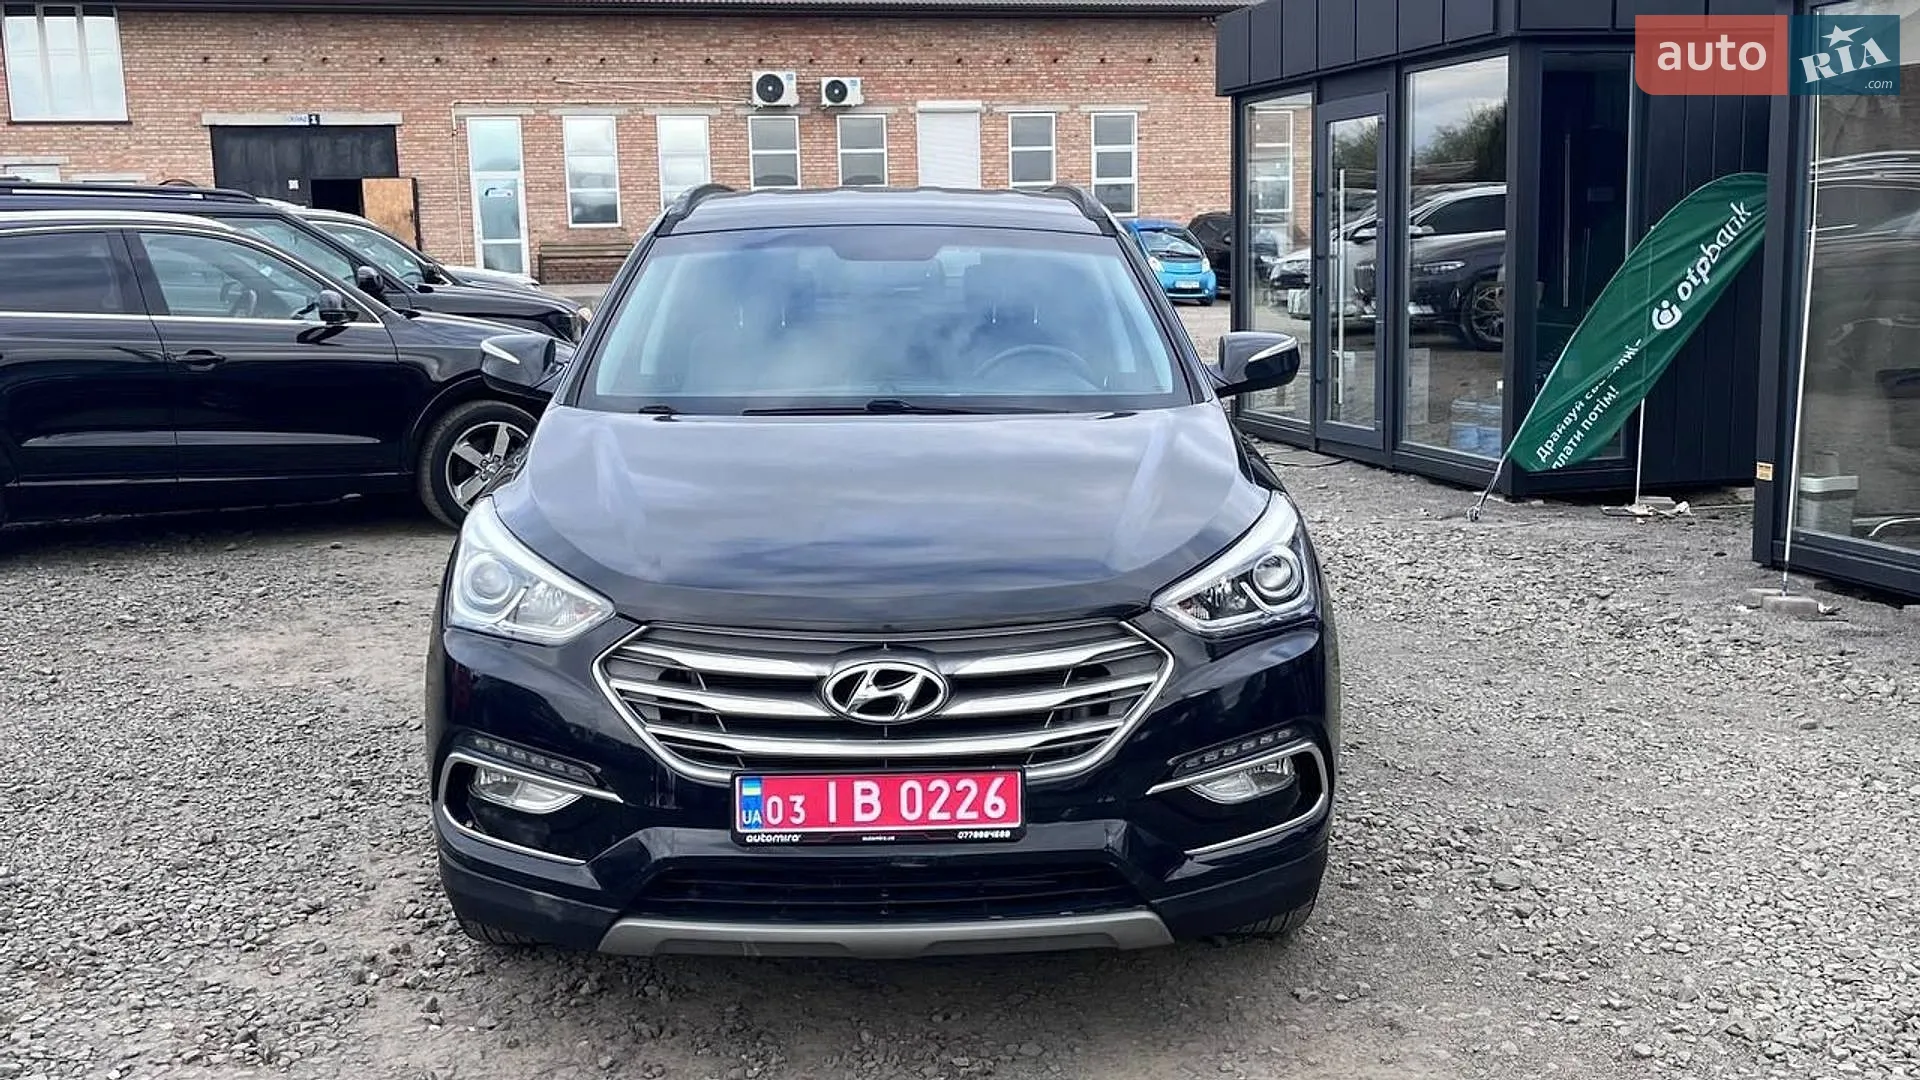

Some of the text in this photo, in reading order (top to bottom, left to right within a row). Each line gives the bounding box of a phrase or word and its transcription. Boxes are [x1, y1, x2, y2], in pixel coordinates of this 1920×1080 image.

[1677, 202, 1751, 301] otpbank
[1536, 400, 1585, 463] Драйвуй
[1552, 385, 1620, 470] плати потім!
[743, 809, 762, 825] UA
[766, 795, 806, 825] 03
[900, 777, 1007, 821] 0226
